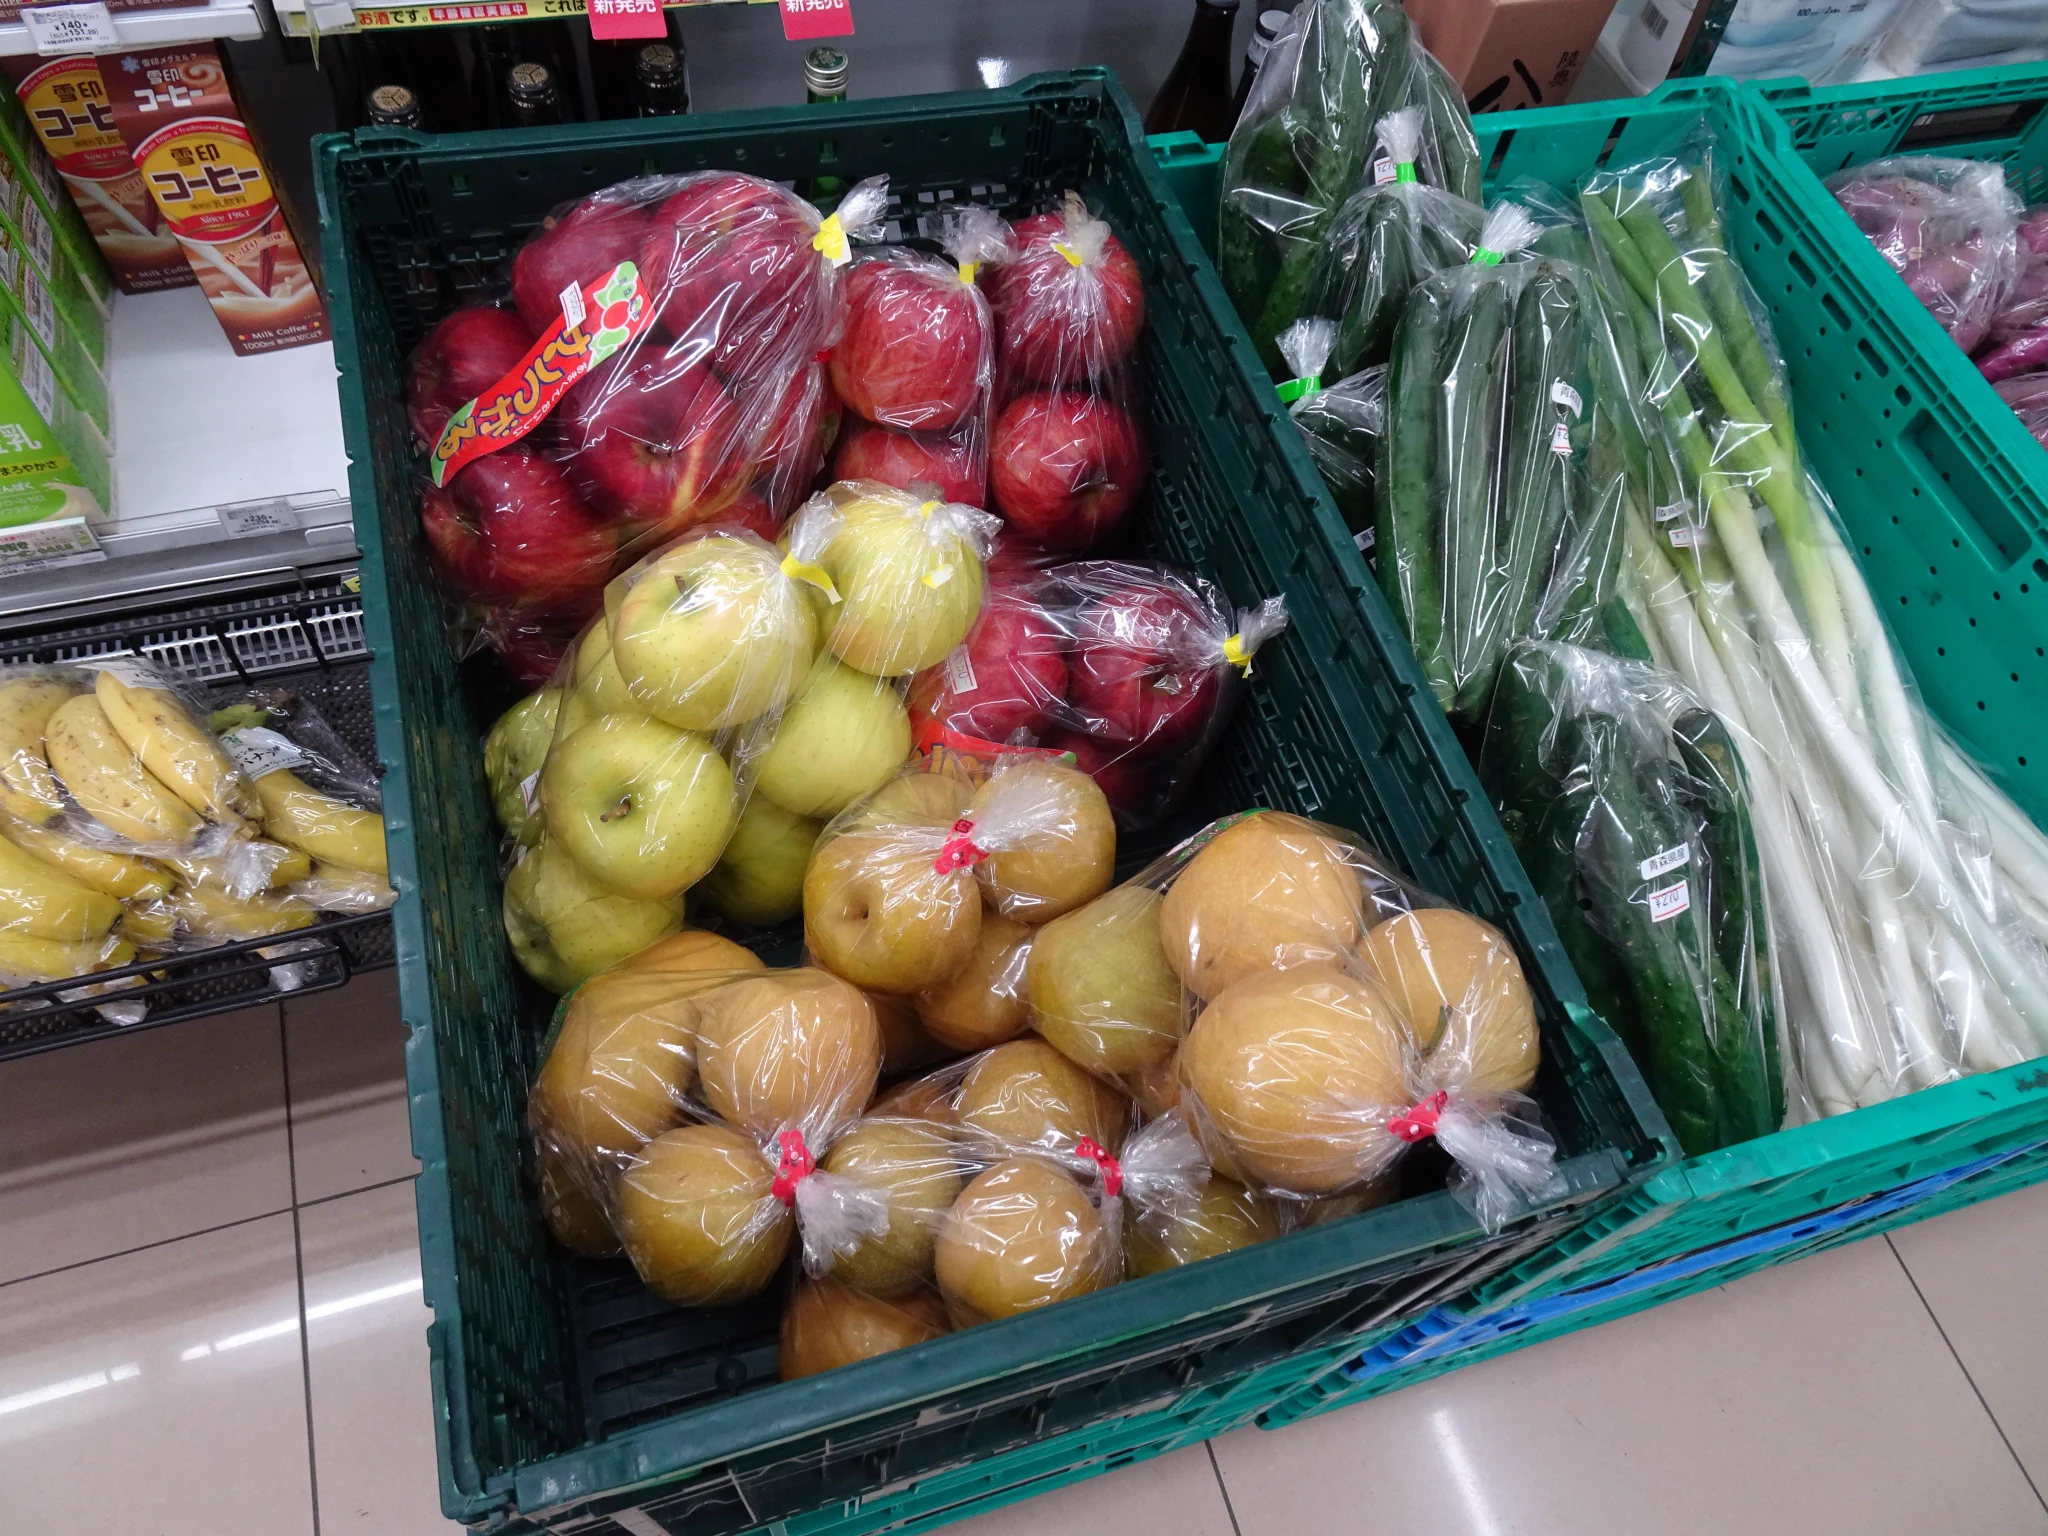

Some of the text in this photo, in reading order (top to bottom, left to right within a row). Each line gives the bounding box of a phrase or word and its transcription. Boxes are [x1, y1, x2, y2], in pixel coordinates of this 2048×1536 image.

[594, 0, 657, 14] 新発売
[786, 0, 844, 13] 新発売
[359, 9, 428, 26] お酒です。
[146, 67, 180, 85] 雪印
[52, 80, 103, 103] 雪印
[134, 85, 204, 112] コーヒー
[33, 102, 120, 138] コーヒ
[170, 144, 221, 167] 雪印
[151, 165, 261, 202] コーヒー
[200, 210, 250, 225] Since 1963
[251, 325, 308, 340] Milk Coffee
[243, 340, 276, 351] 1000ml
[0, 460, 58, 475] まろやかさ
[1648, 847, 1686, 872] 青森県産
[1656, 889, 1679, 908] ¥270
